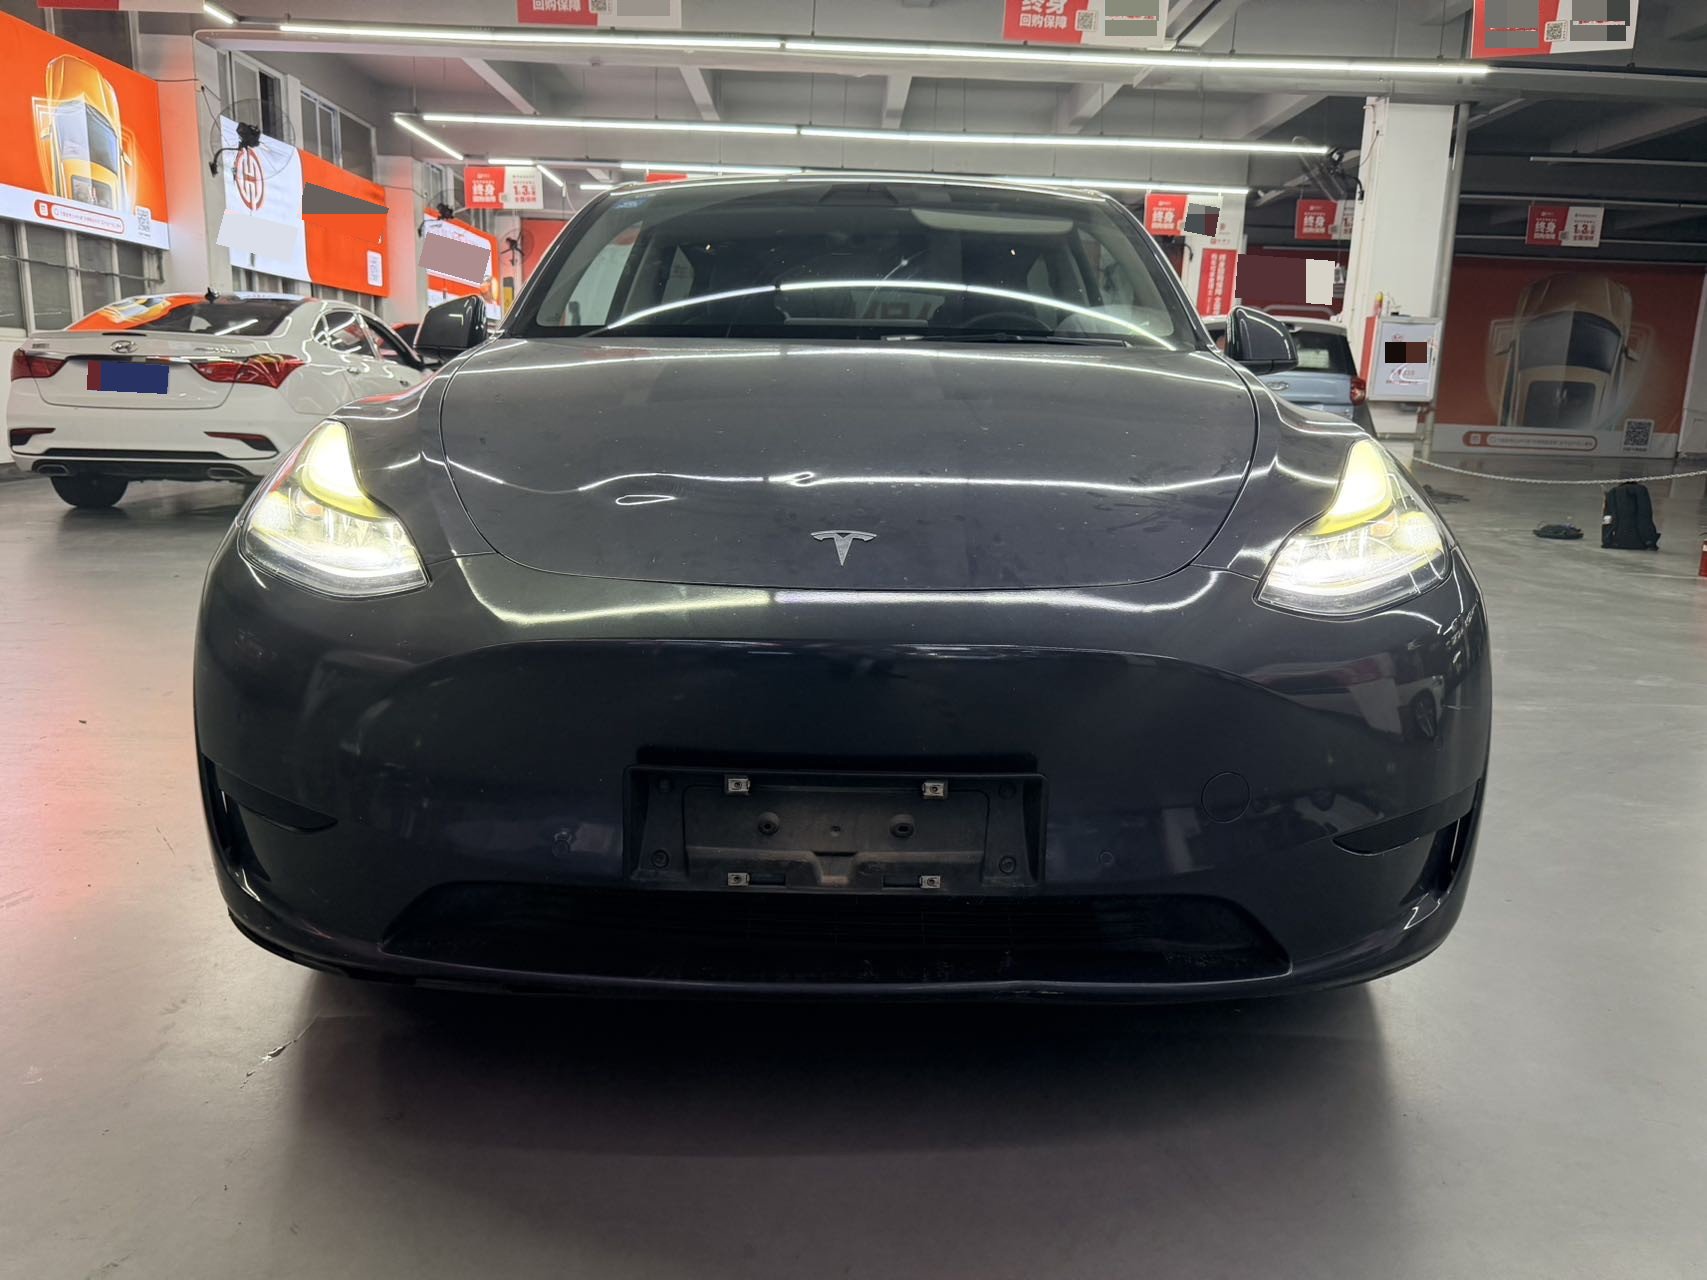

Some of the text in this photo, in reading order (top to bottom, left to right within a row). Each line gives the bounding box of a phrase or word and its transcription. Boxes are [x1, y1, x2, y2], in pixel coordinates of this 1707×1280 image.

[533, 0, 581, 11] 回购保障
[1019, 13, 1068, 29] 回购保障
[472, 183, 495, 196] 终身
